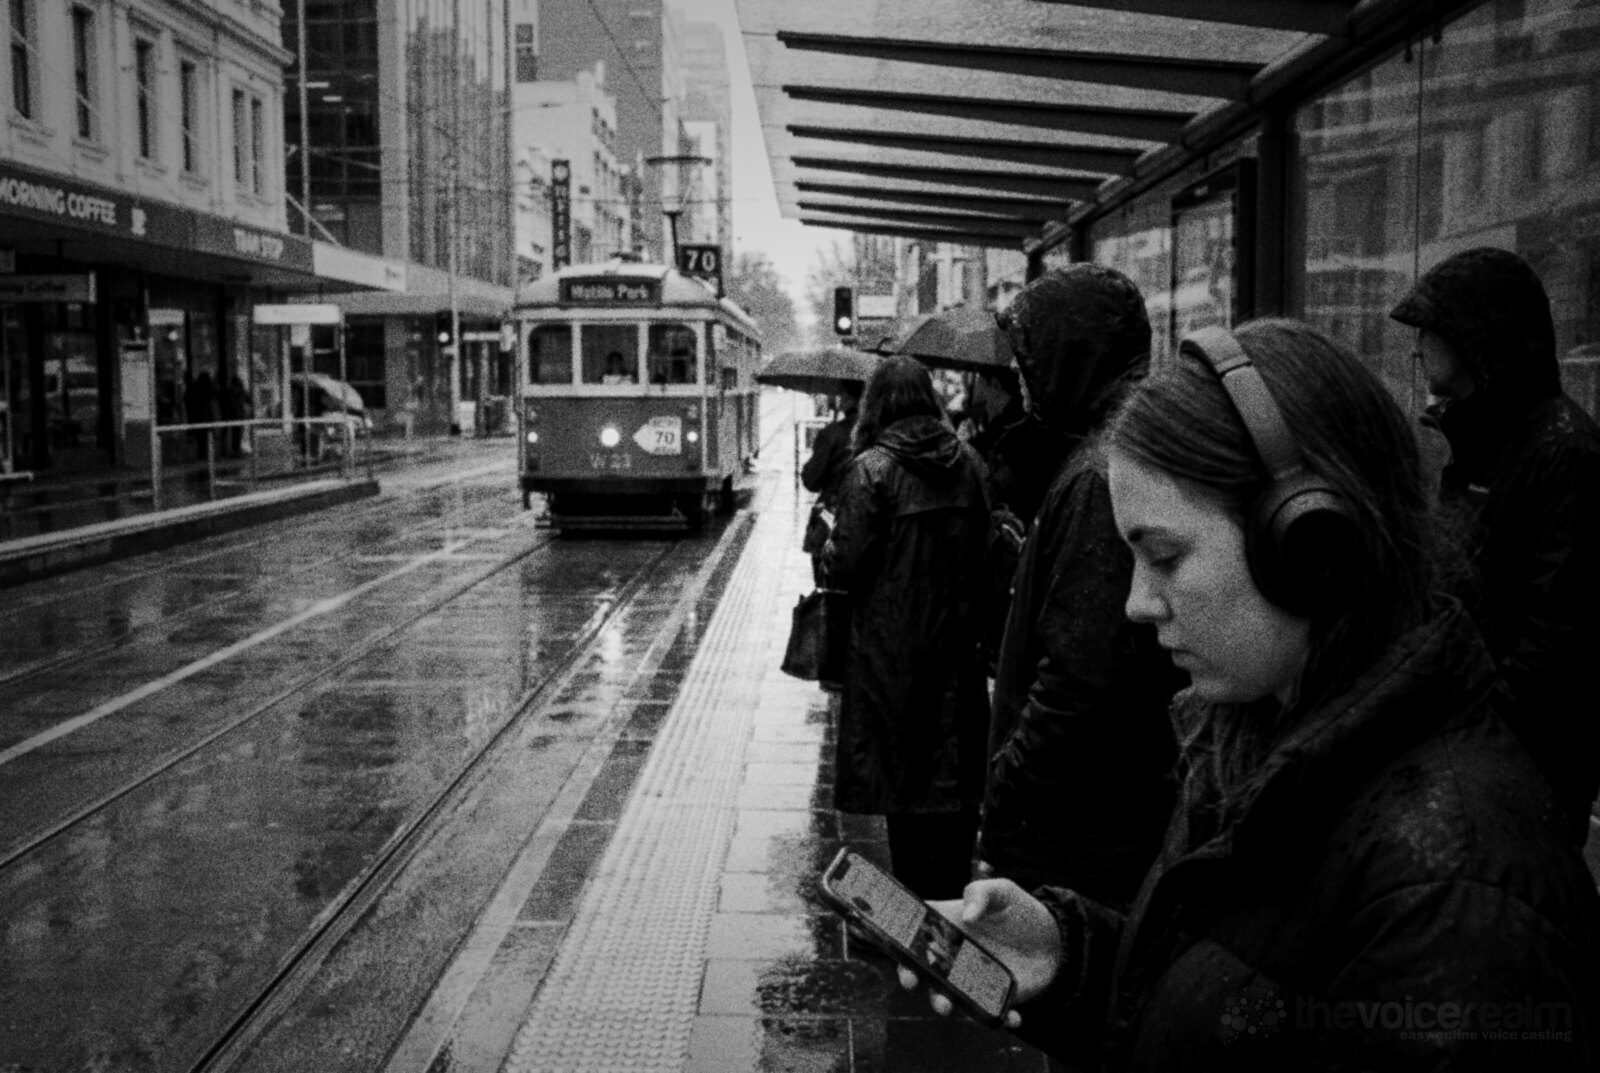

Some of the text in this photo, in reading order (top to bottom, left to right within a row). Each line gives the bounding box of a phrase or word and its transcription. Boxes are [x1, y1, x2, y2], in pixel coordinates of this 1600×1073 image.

[67, 192, 117, 225] COFFEE
[686, 250, 716, 272] 70
[655, 431, 675, 445] 70
